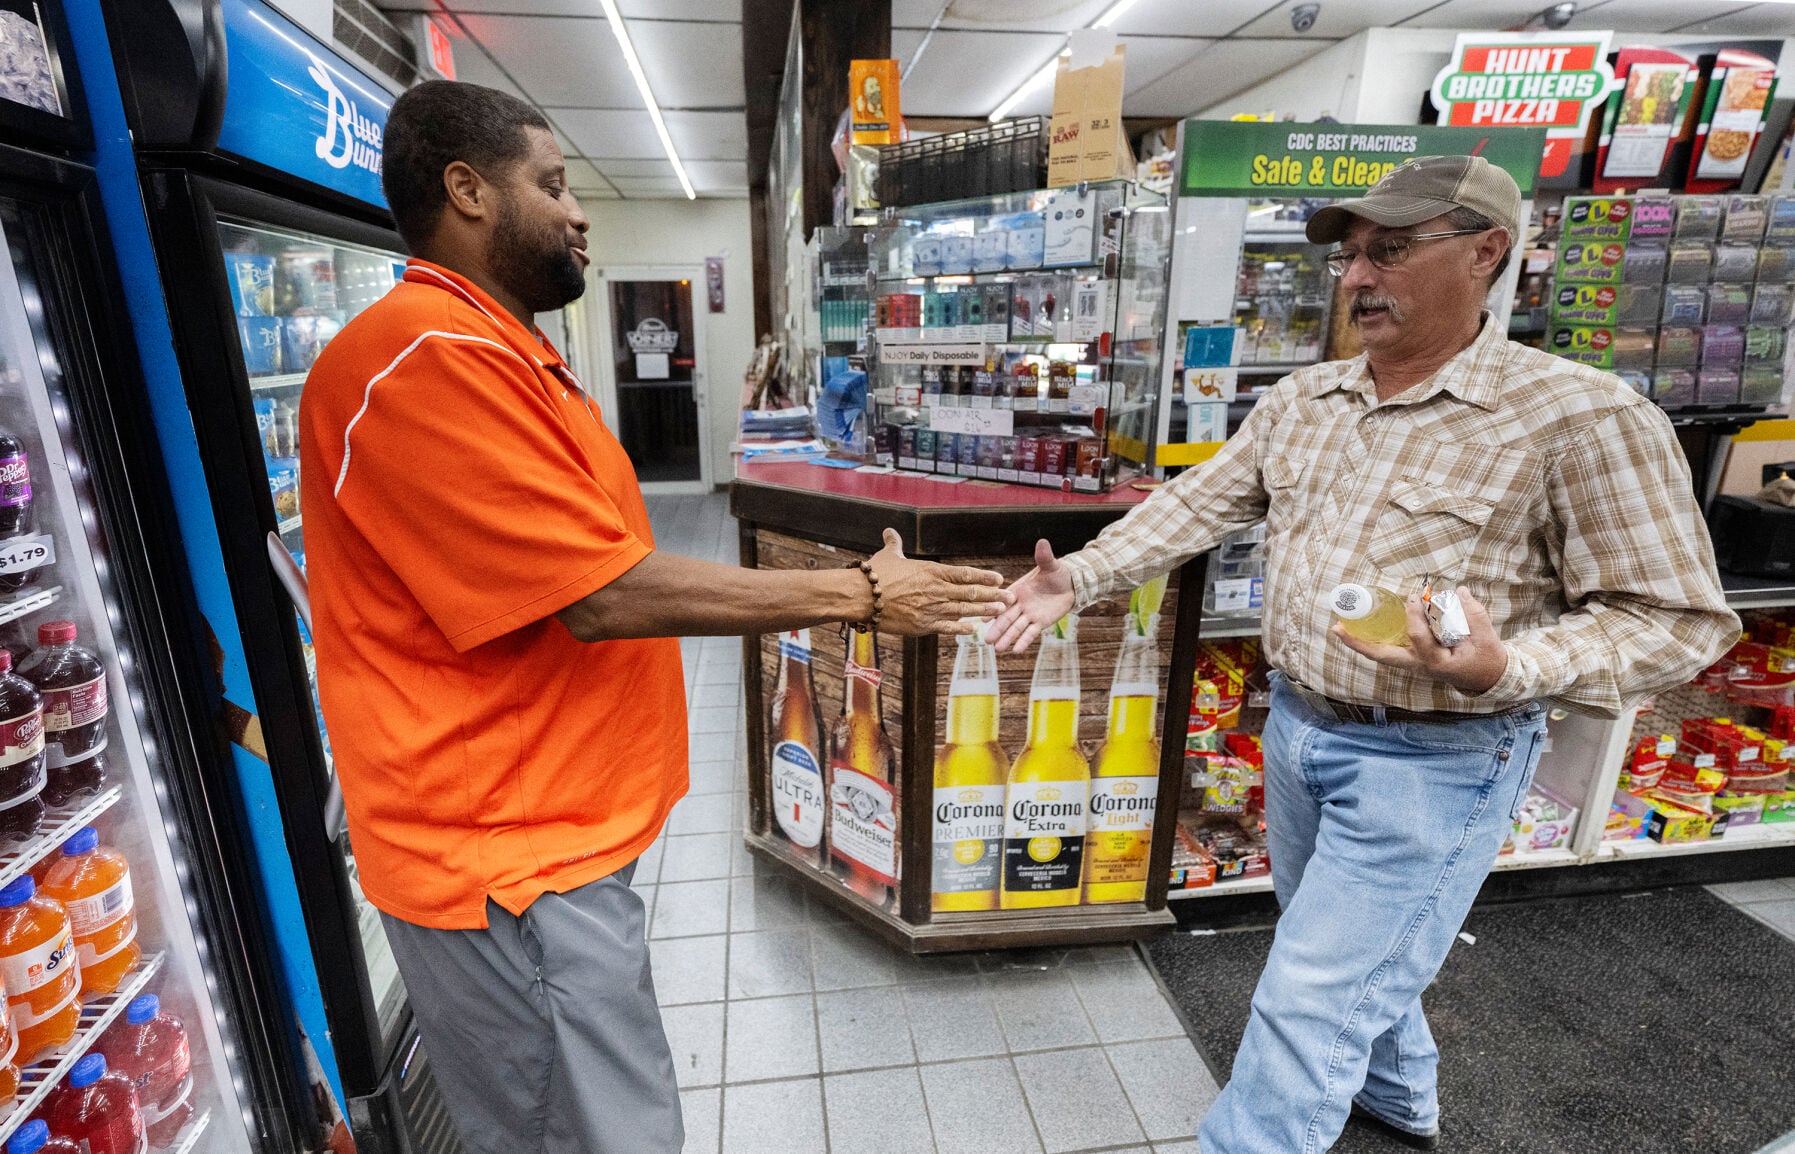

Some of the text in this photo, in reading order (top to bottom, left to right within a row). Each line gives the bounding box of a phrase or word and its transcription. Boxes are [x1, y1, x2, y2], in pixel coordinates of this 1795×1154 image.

[1484, 47, 1571, 74] HUNT
[1447, 74, 1597, 99] BROTHERS
[1472, 98, 1559, 124] PIZZA
[1053, 129, 1080, 144] RAW
[1287, 133, 1417, 152] CDC BEST PRACTICES
[1252, 154, 1302, 185] Safe
[1308, 155, 1326, 185] &
[884, 351, 980, 361] NJOY Daily Disposable
[0, 547, 45, 569] $1.79
[775, 775, 823, 811] ULTRA
[936, 802, 1004, 826] Corona
[1013, 799, 1082, 824] Corona
[1106, 812, 1140, 826] Light
[834, 808, 892, 847] Budweiser
[935, 824, 1004, 840] PREMIER
[1027, 818, 1066, 831] Extra
